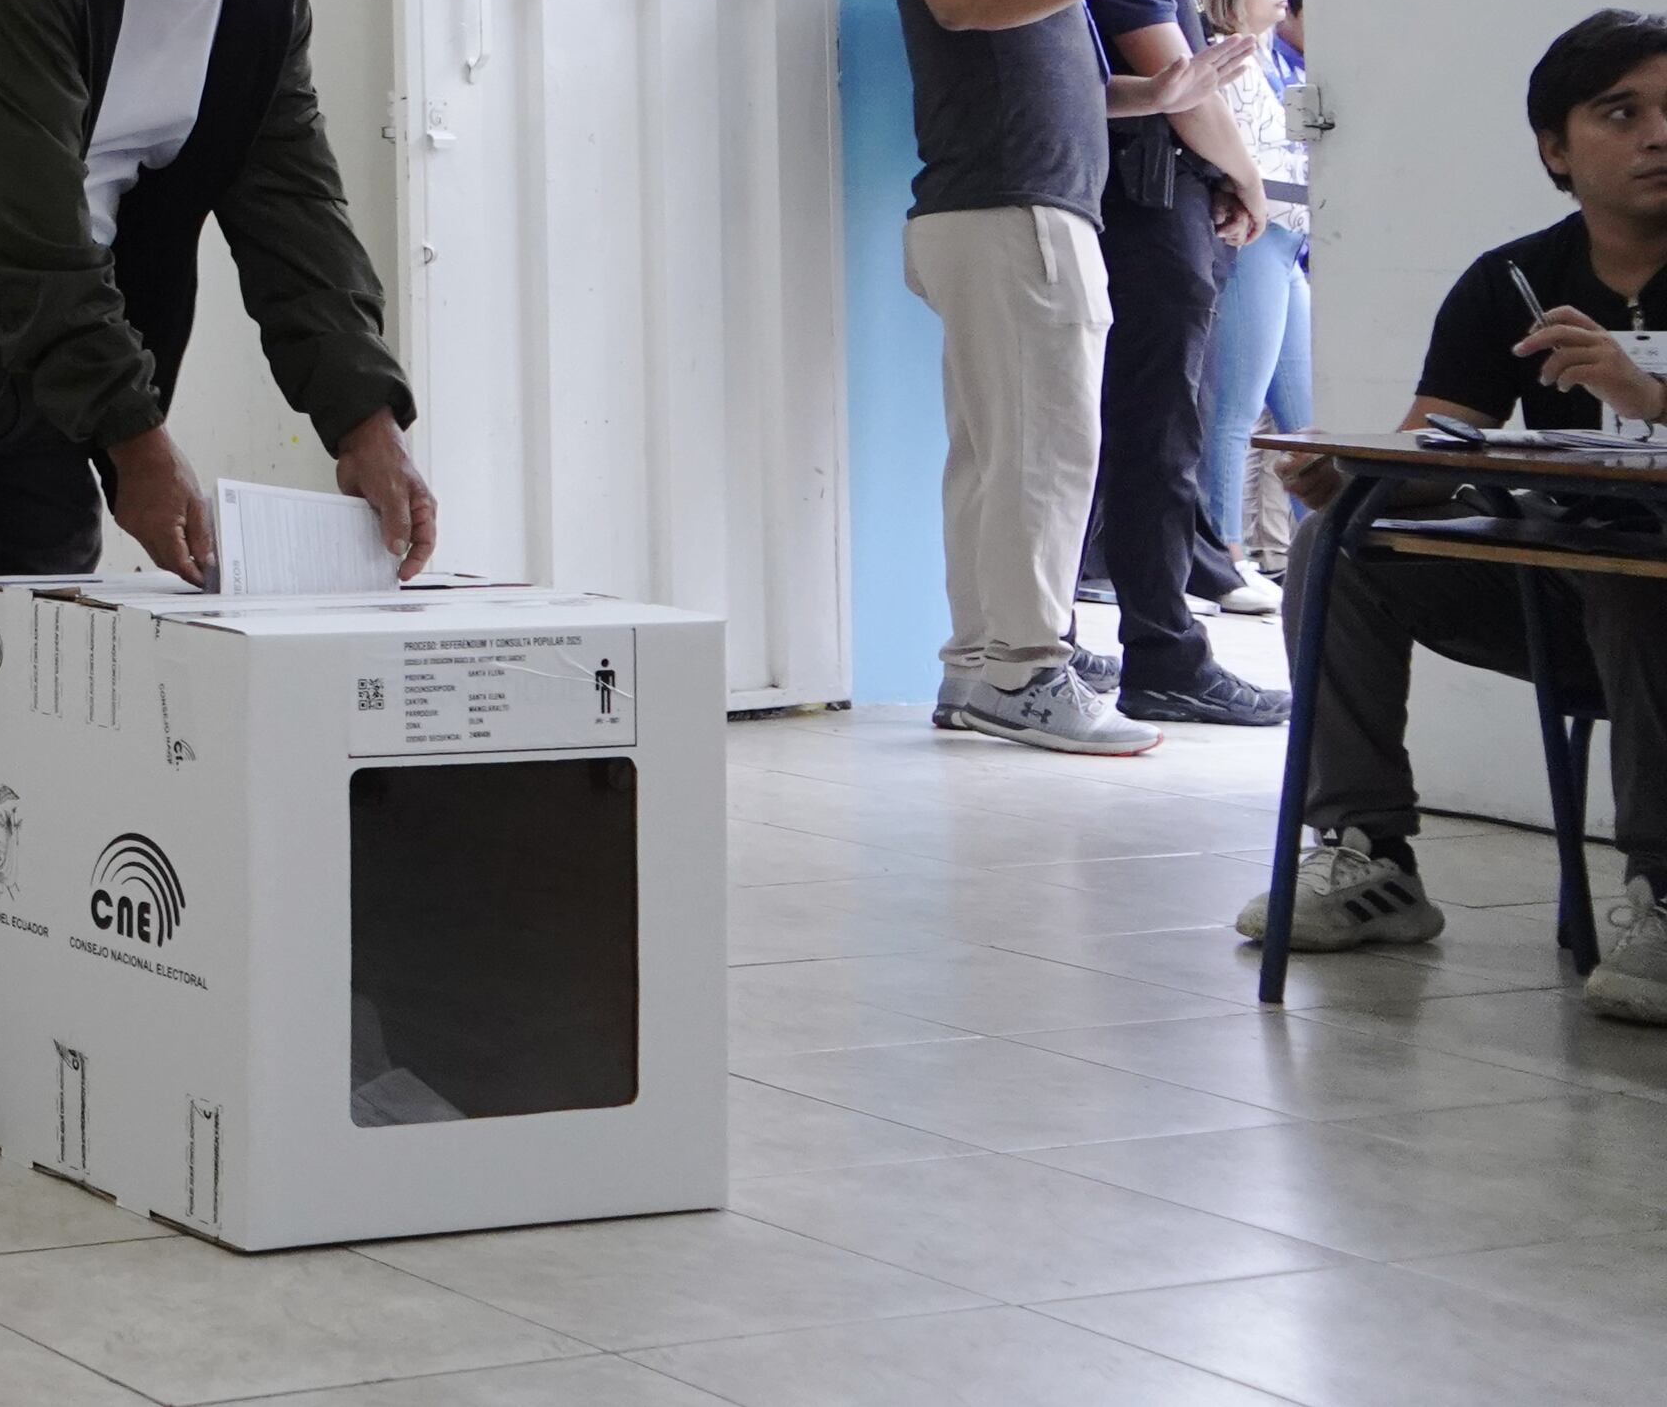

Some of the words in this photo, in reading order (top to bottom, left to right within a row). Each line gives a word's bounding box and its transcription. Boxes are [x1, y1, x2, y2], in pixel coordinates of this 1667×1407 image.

[404, 641, 437, 651] PROCESO:
[489, 639, 494, 648] Y
[496, 637, 531, 647] CONSULTA
[533, 636, 564, 646] POPULAR
[158, 683, 171, 734] CONSEJO
[12, 916, 49, 938] ECUADOR
[91, 889, 152, 945] CNE
[69, 936, 108, 959] CONSEJO
[111, 946, 154, 973] NACIONAL
[156, 963, 209, 991] ELECTORAL
